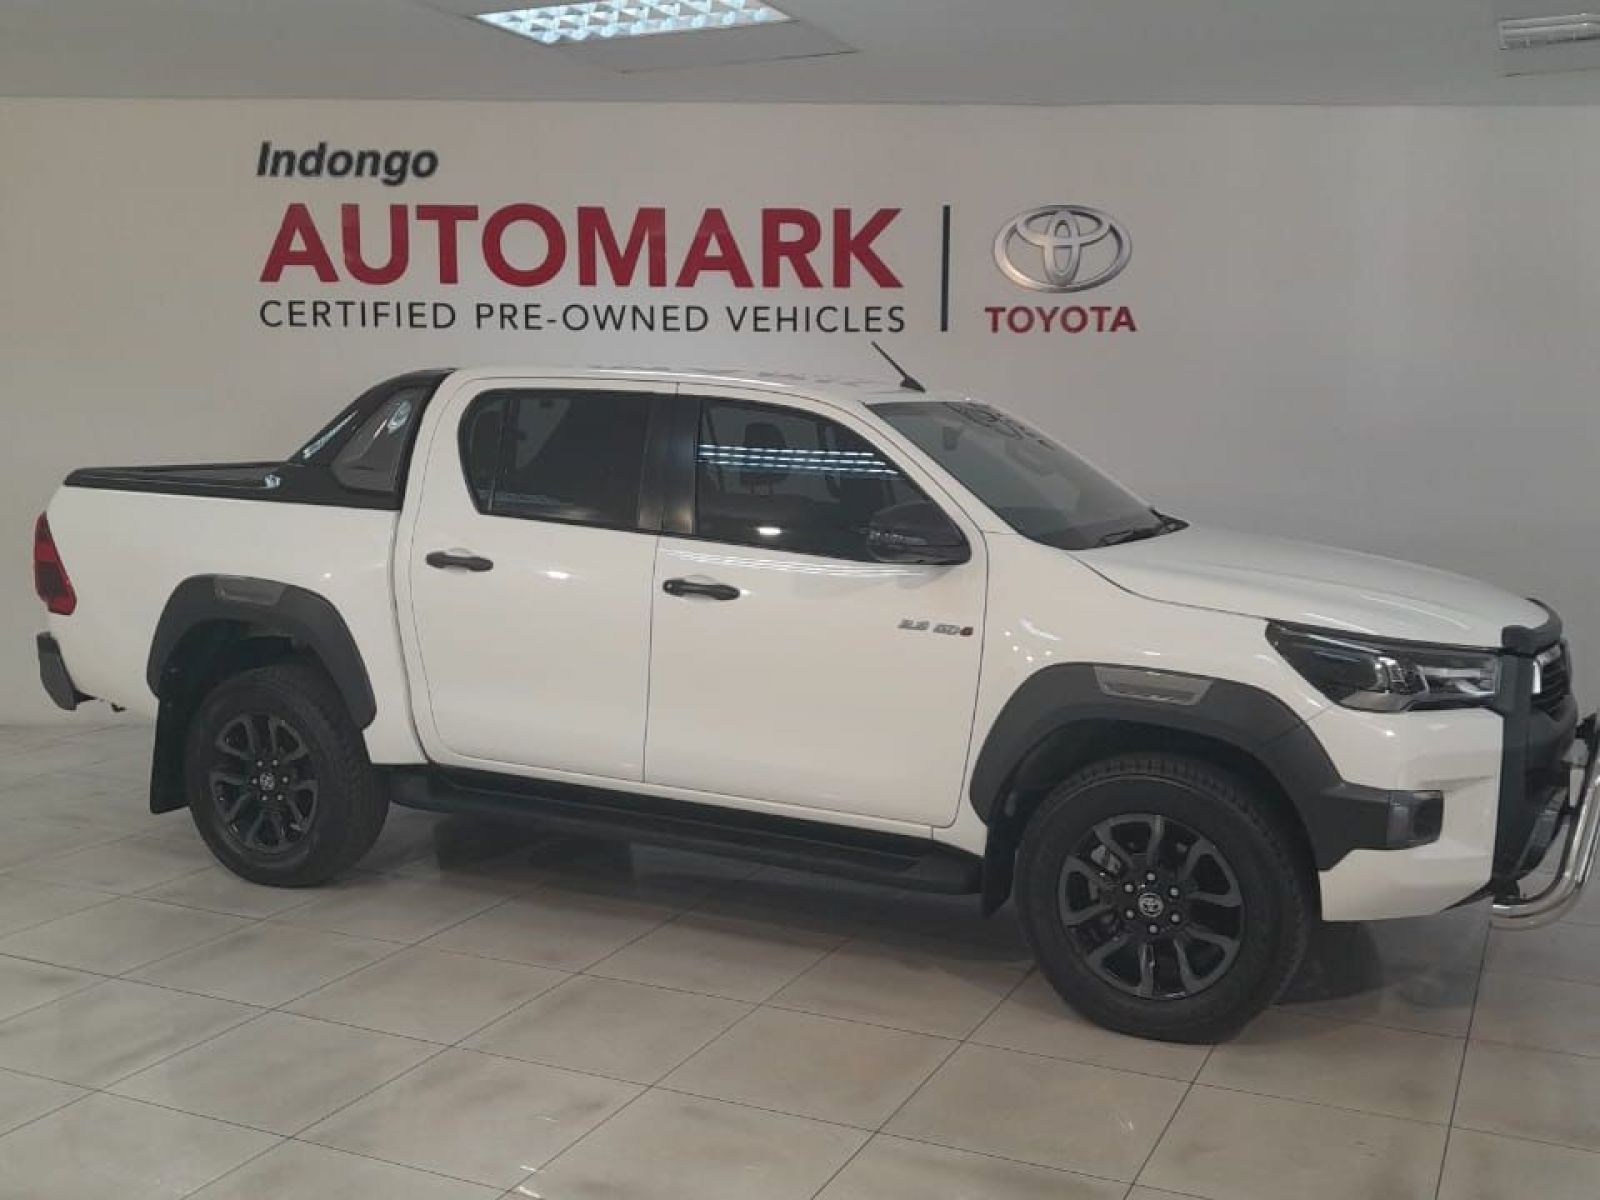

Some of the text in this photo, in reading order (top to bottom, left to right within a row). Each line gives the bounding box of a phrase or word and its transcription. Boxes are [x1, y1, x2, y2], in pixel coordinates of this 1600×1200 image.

[256, 141, 438, 187] Indongo
[259, 203, 904, 288] AUTOMARK
[259, 300, 905, 333] CERTIFIED PRE-OWNED VEHICLES
[985, 306, 1137, 333] TOYOTA
